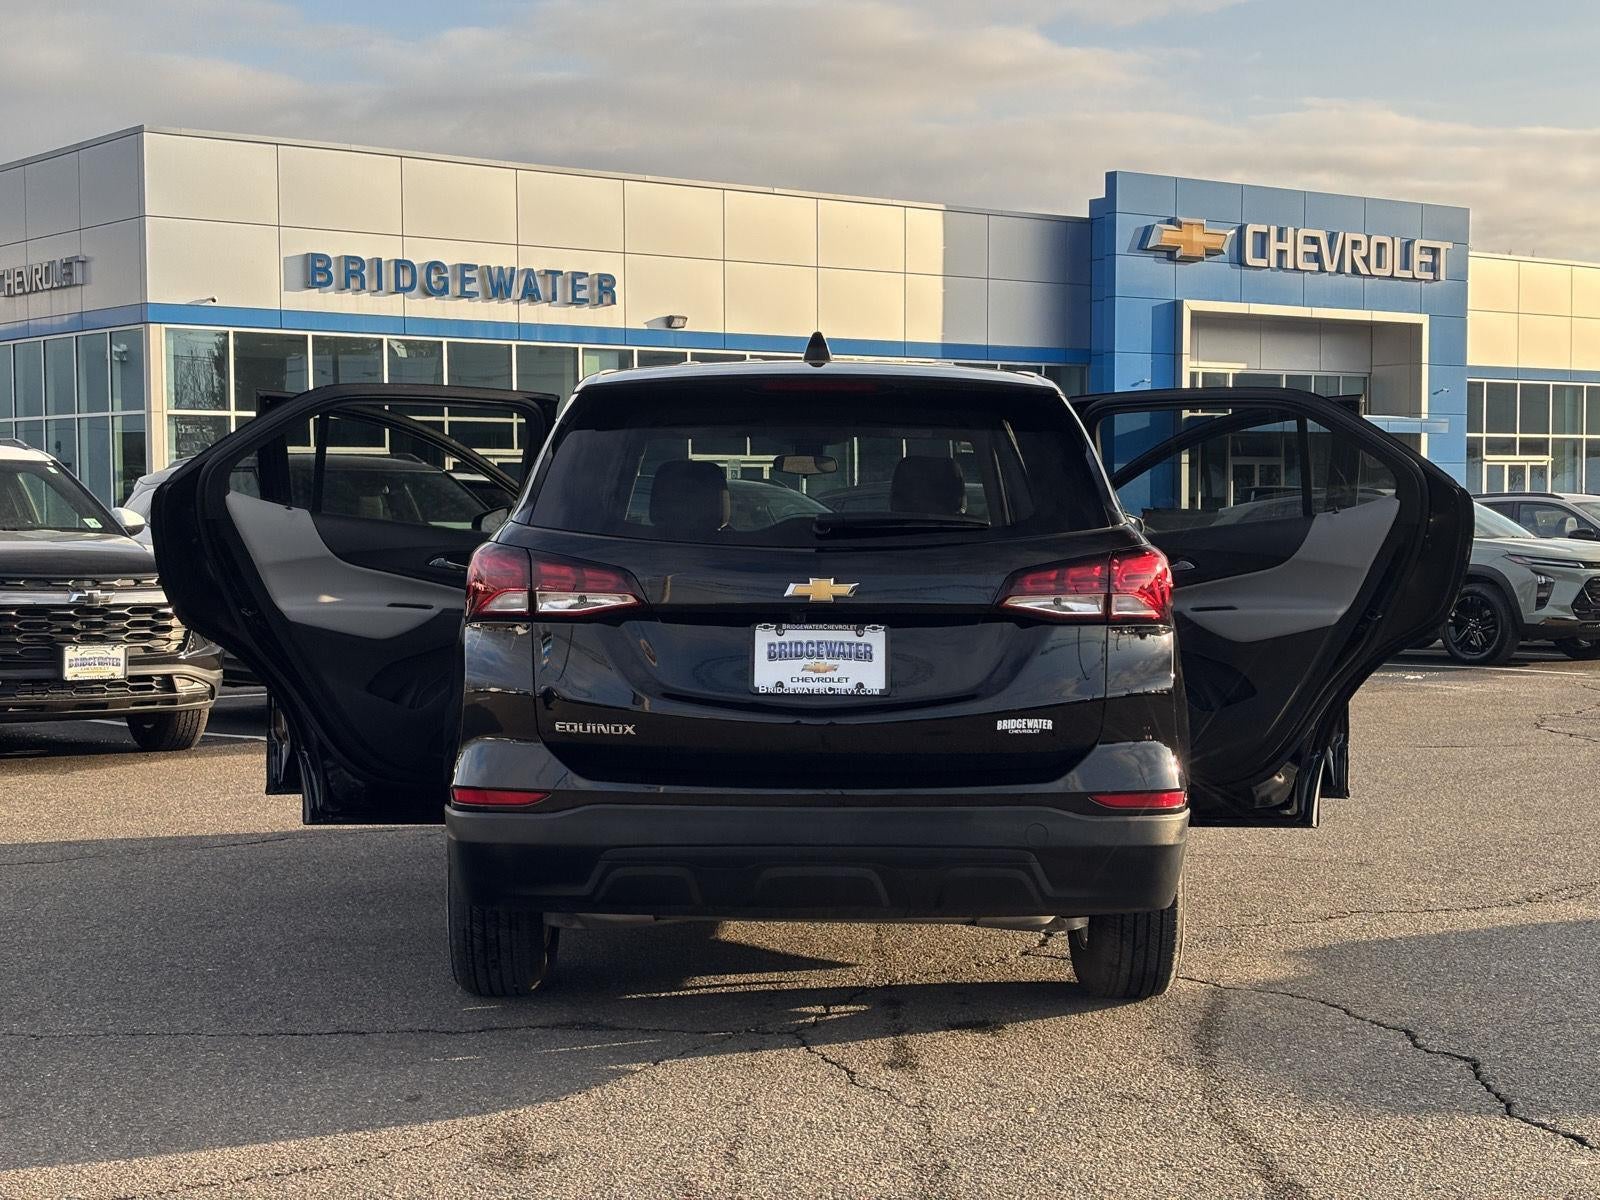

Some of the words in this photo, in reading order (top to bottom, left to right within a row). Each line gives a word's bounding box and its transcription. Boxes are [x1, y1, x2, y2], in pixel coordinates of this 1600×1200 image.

[1244, 223, 1454, 281] CHEVROLET
[307, 252, 617, 305] BRIDGEWATER
[766, 640, 874, 662] BRIDGEWATER
[790, 676, 850, 684] CHEVROLET
[554, 721, 637, 735] EQUINOX
[996, 718, 1053, 730] BRIDGEWATER
